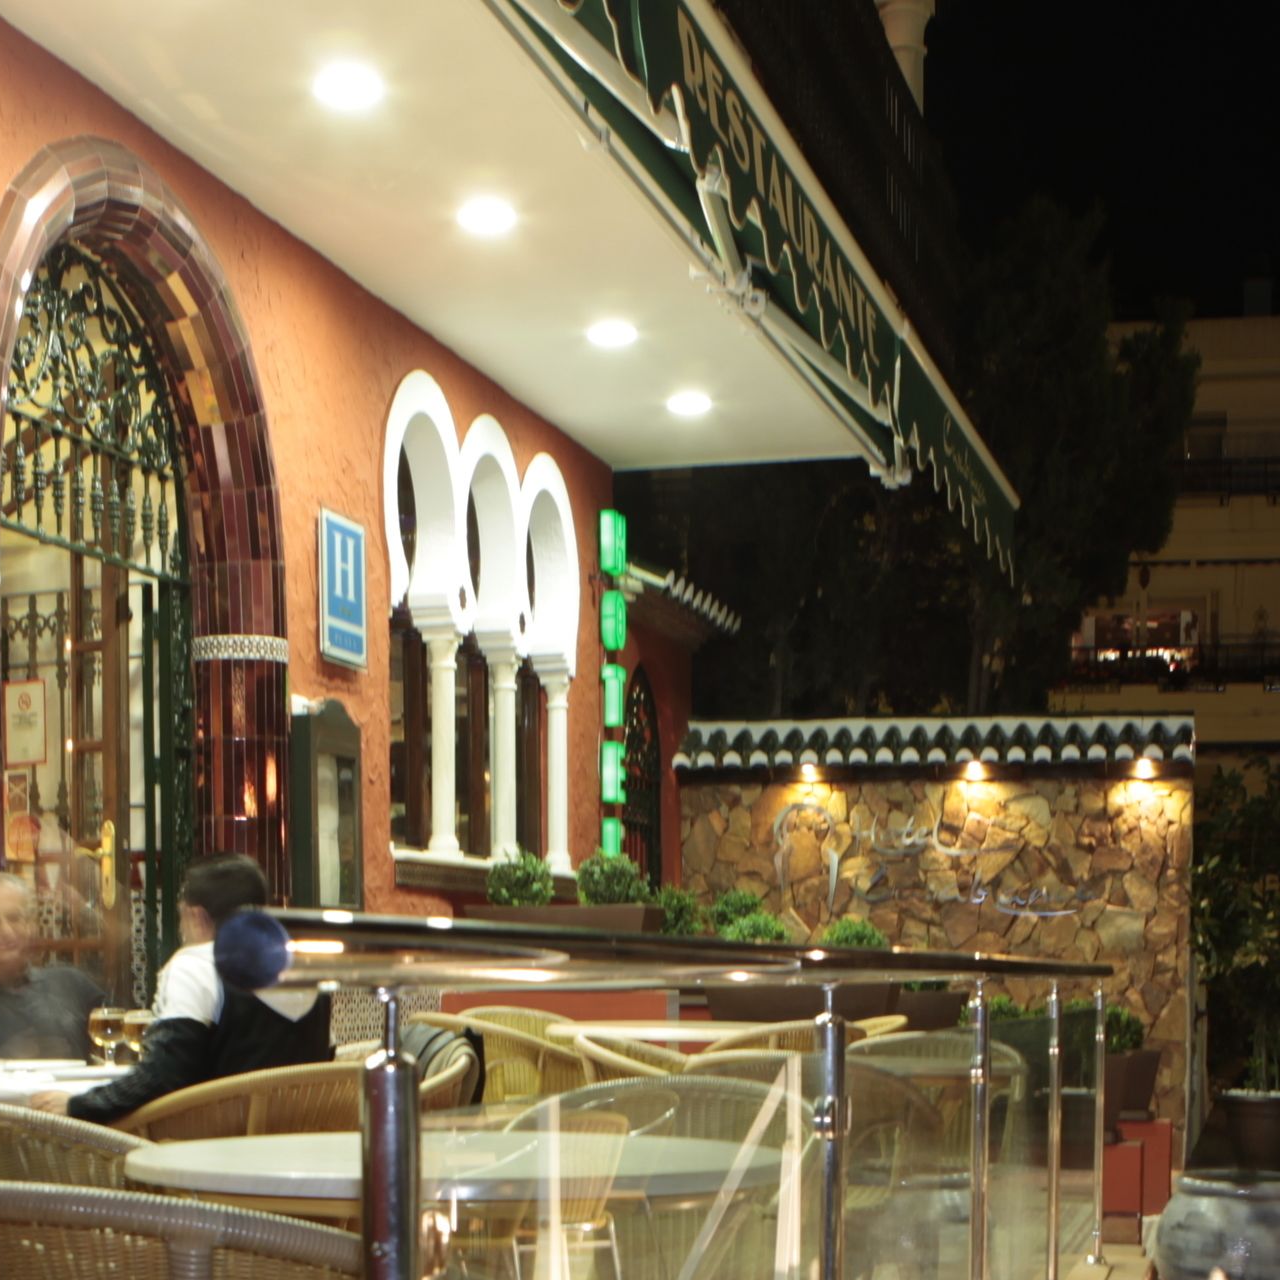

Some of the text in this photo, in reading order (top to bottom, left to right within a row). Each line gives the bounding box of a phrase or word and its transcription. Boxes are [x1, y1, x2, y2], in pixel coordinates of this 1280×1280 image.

[677, 6, 880, 367] RESTAURANTE
[333, 530, 356, 602] H
[851, 811, 1023, 857] Hotel
